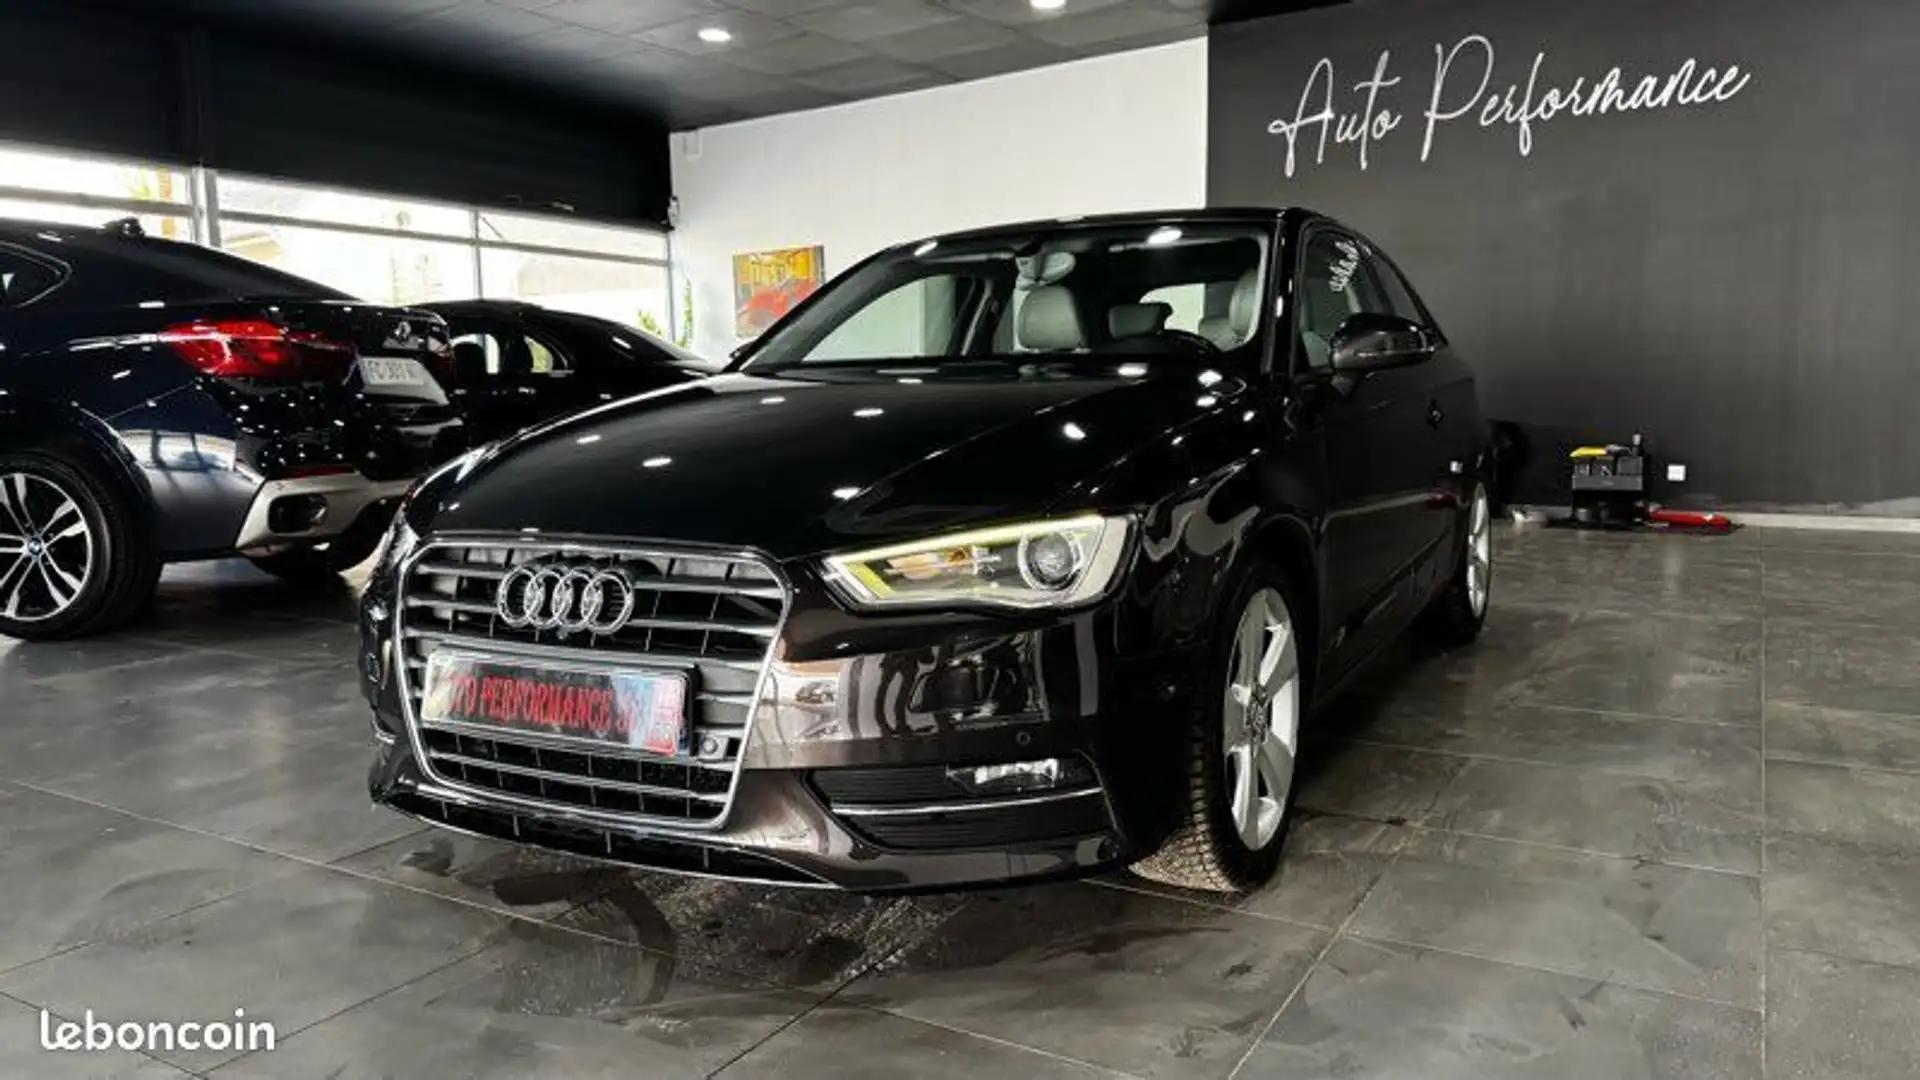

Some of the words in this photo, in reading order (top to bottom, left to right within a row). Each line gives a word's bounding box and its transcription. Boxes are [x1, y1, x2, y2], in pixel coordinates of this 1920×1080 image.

[1267, 50, 1403, 178] Auto
[1420, 34, 1751, 163] Performance
[480, 674, 614, 733] PERFORMANCE
